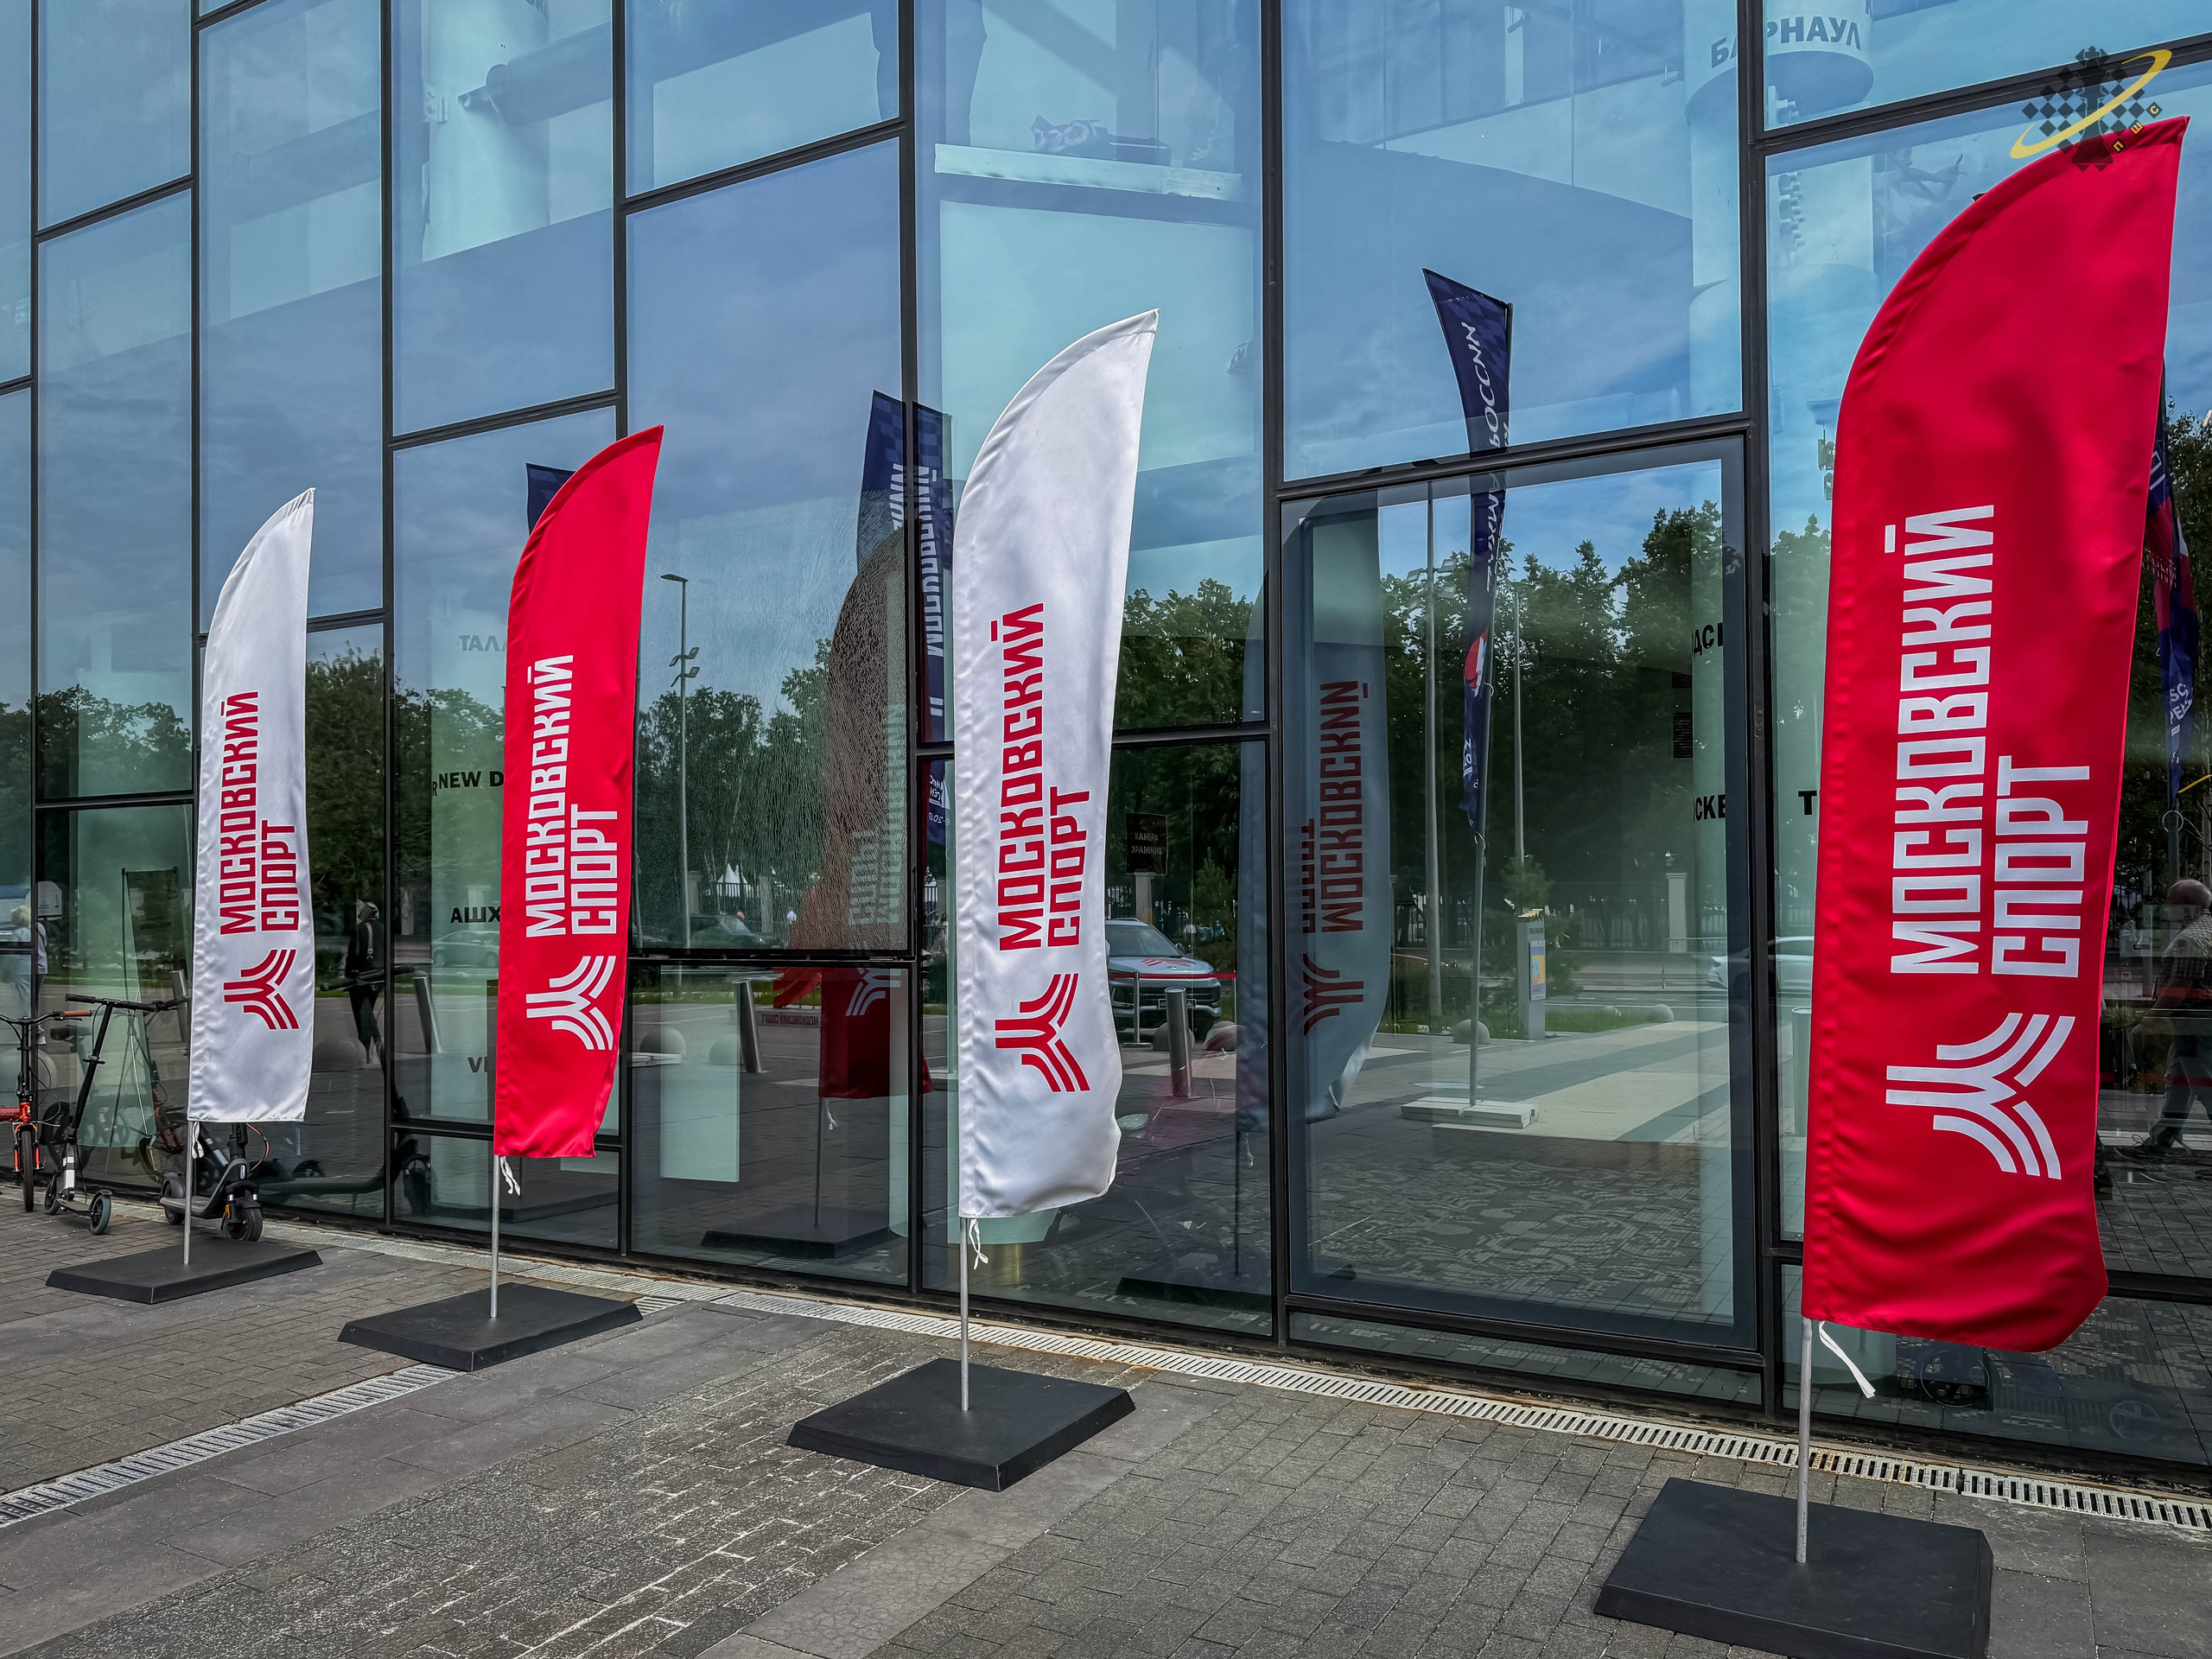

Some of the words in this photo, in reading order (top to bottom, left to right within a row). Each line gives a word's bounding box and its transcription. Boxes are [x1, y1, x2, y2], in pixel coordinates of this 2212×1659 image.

[219, 691, 259, 936] МОСКОВСКИЙ
[439, 771, 482, 789] NEW
[524, 654, 575, 939] МОСКОВСКИЙ
[990, 602, 1045, 951] МОСКОВСКИЙ
[1885, 504, 1995, 977] МОСКОВСКИЙ
[261, 819, 299, 931] СПОРТ
[570, 803, 618, 935] СПОРТ
[1047, 785, 1090, 948] СПОРТ
[1991, 754, 2090, 978] СПОРТ
[467, 1056, 488, 1074] V
